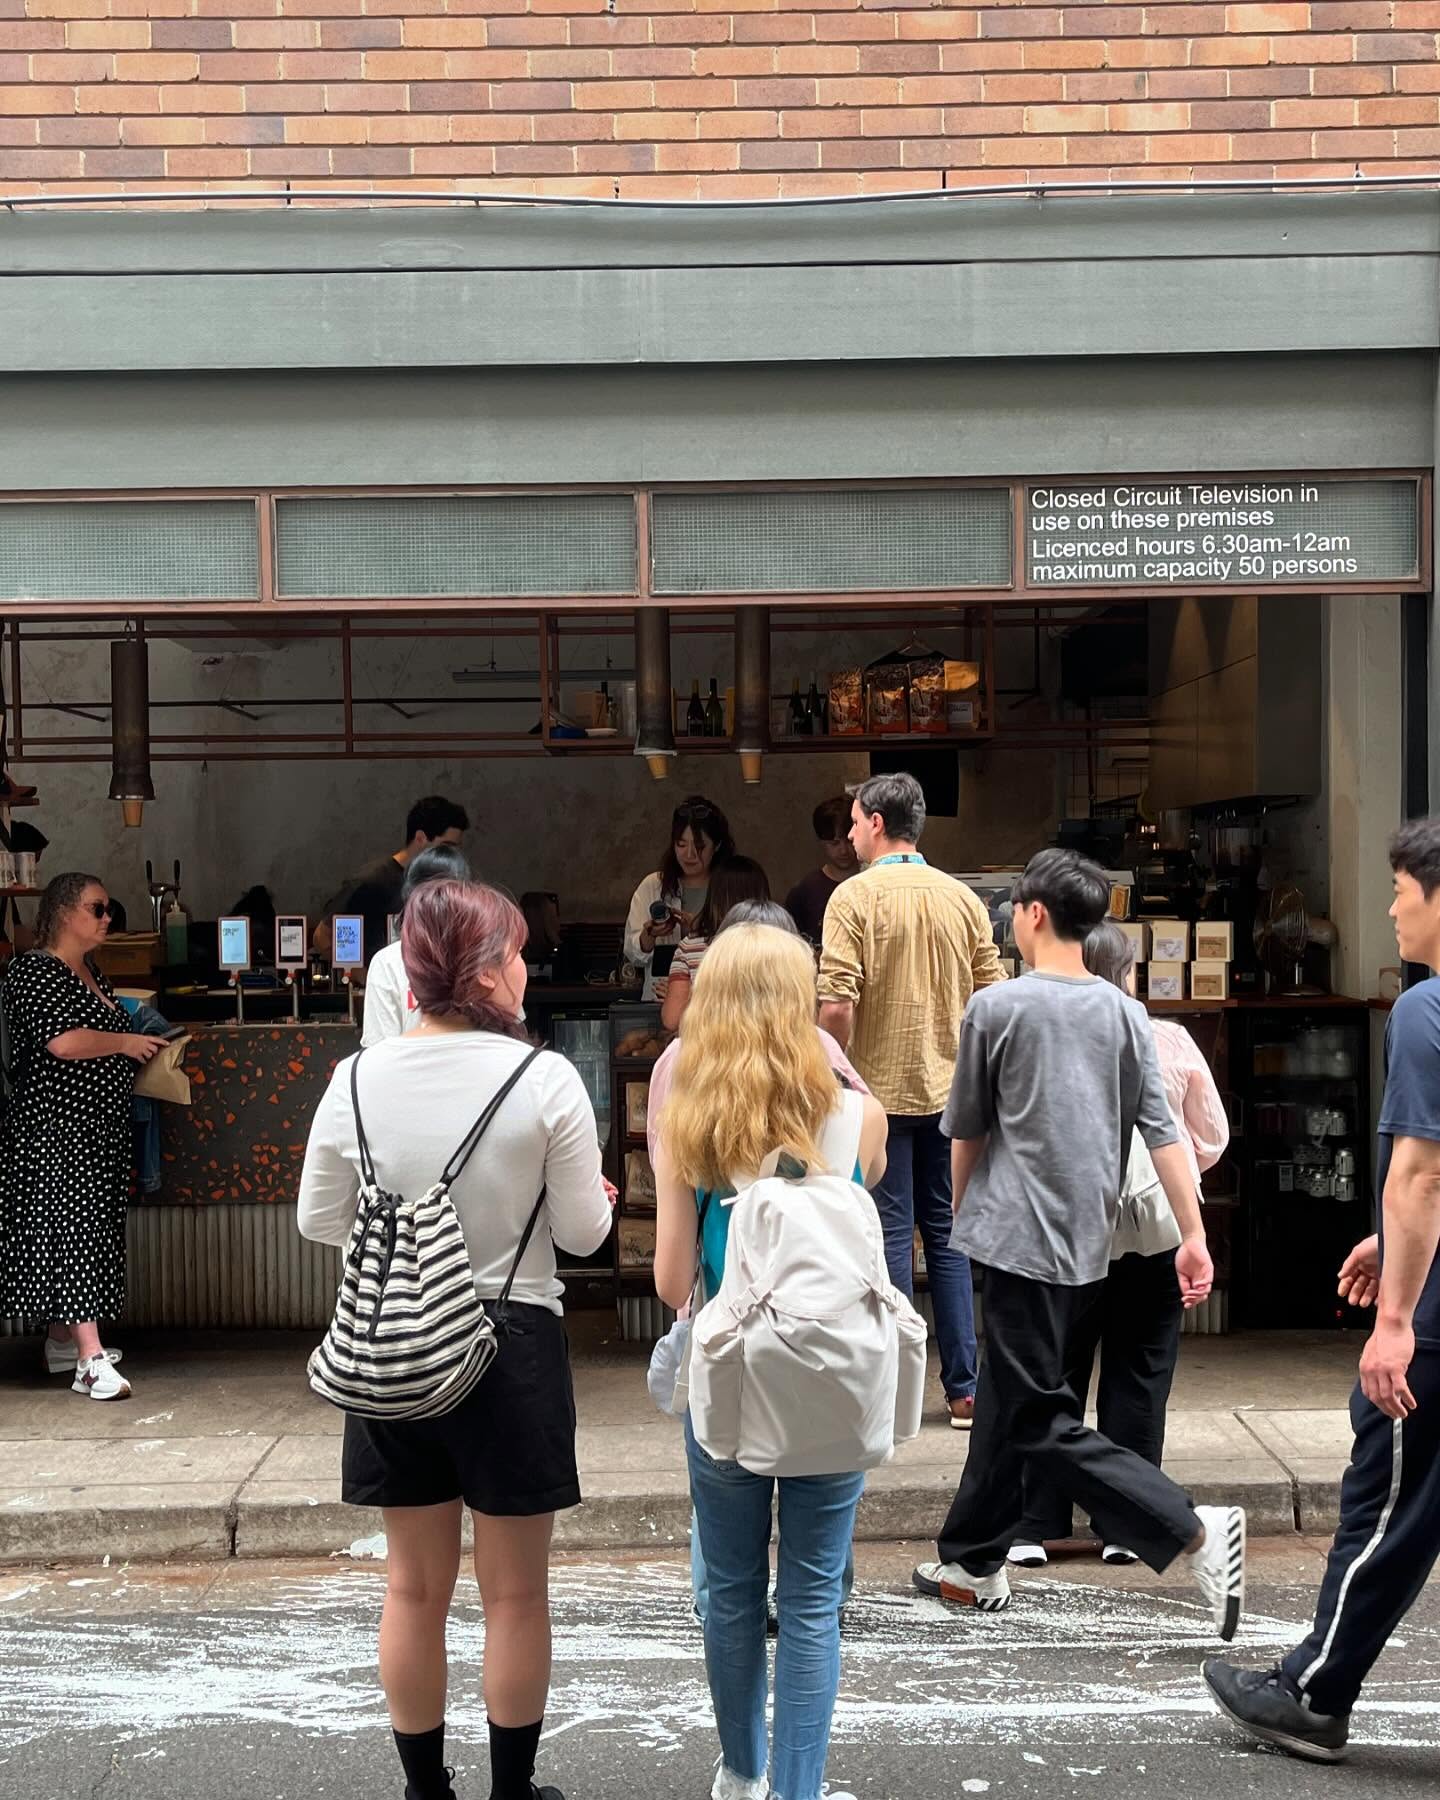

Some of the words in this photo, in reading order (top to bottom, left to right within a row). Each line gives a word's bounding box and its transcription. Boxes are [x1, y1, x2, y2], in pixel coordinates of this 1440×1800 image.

[1031, 488, 1106, 509] Closed
[1113, 486, 1182, 507] Circuit
[1187, 484, 1293, 505] Television
[1300, 483, 1319, 503] in
[1032, 515, 1071, 532] use
[1076, 514, 1104, 530] on
[1109, 509, 1170, 530] these
[1176, 506, 1275, 532] premises
[1032, 536, 1128, 559] Licenced
[1135, 536, 1196, 556] hours
[1201, 531, 1351, 555] 6.30am-12am
[1031, 562, 1136, 581] maximum
[1142, 557, 1233, 583] capacity
[1238, 555, 1266, 576] 50
[1272, 557, 1358, 580] persons
